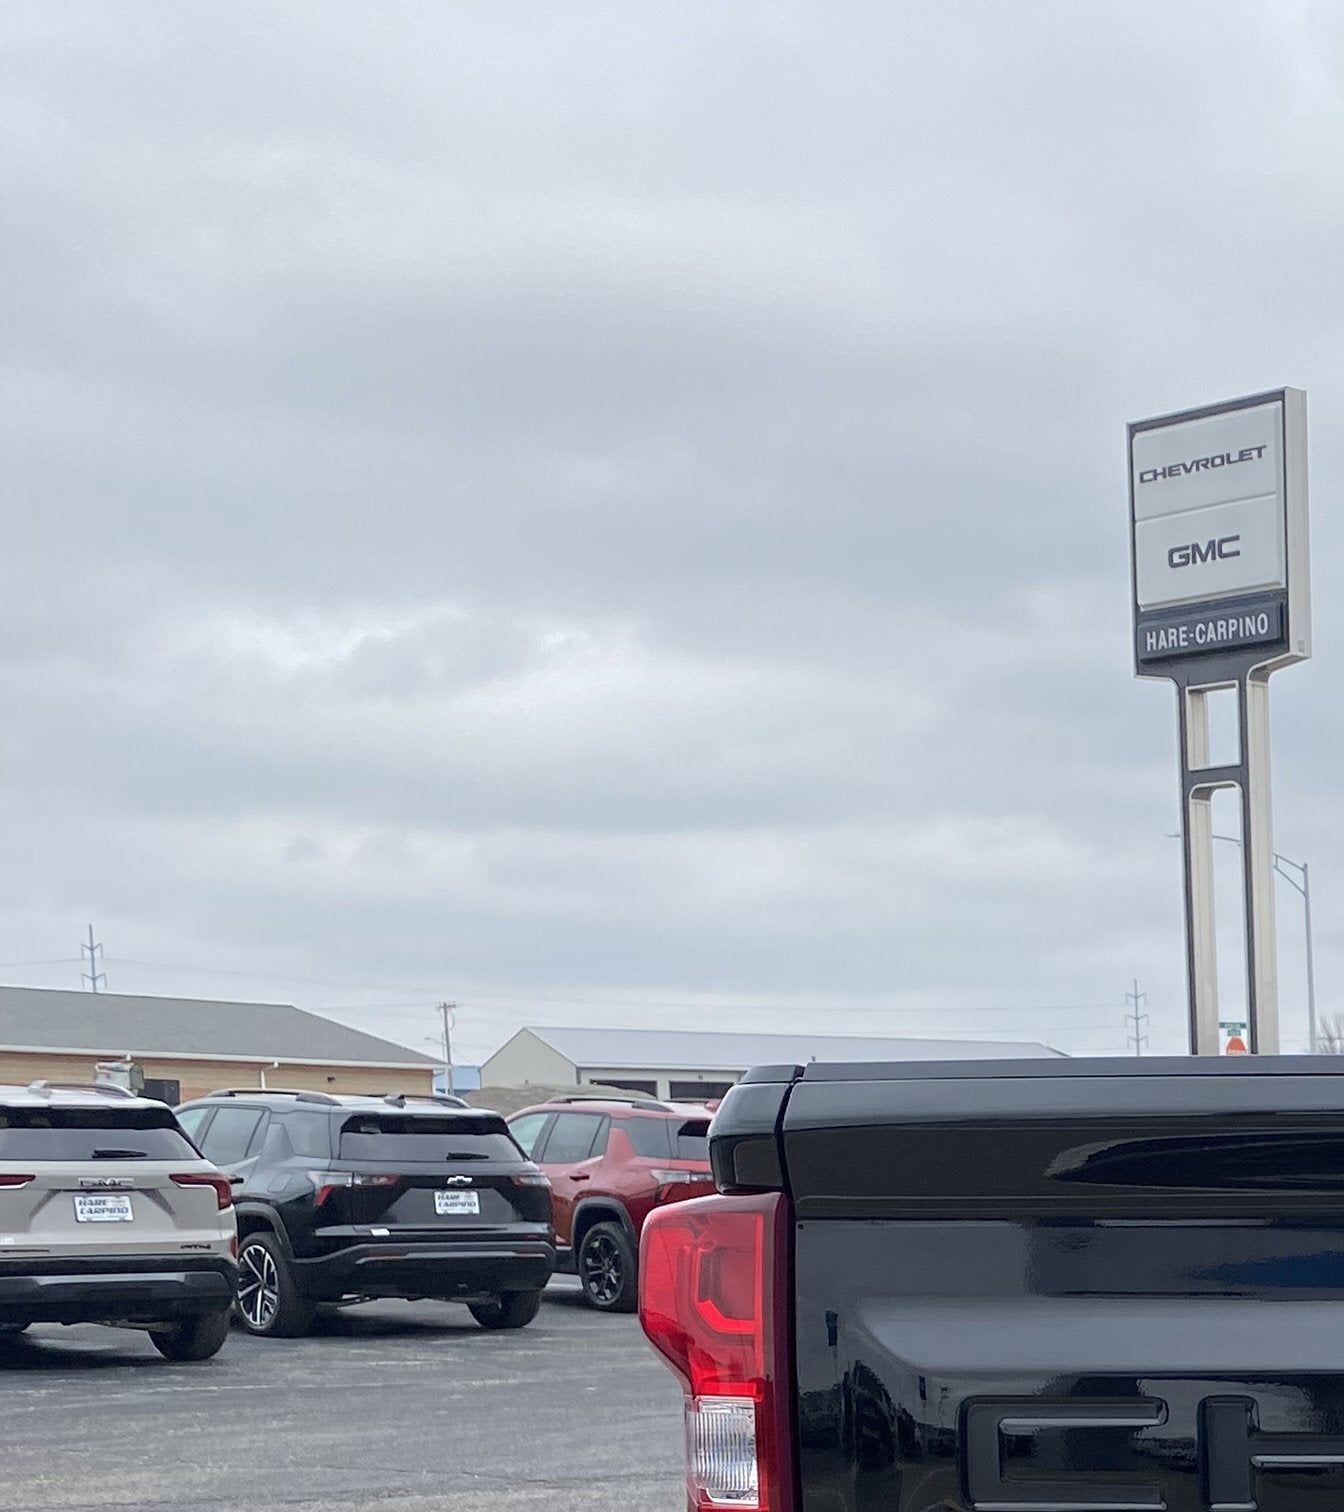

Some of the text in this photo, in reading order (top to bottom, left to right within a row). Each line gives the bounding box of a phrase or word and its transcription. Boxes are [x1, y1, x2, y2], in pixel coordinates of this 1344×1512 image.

[1139, 445, 1267, 483] CHEVROLET
[1167, 535, 1240, 569] GMC
[1146, 613, 1268, 651] HARE-CARPINO
